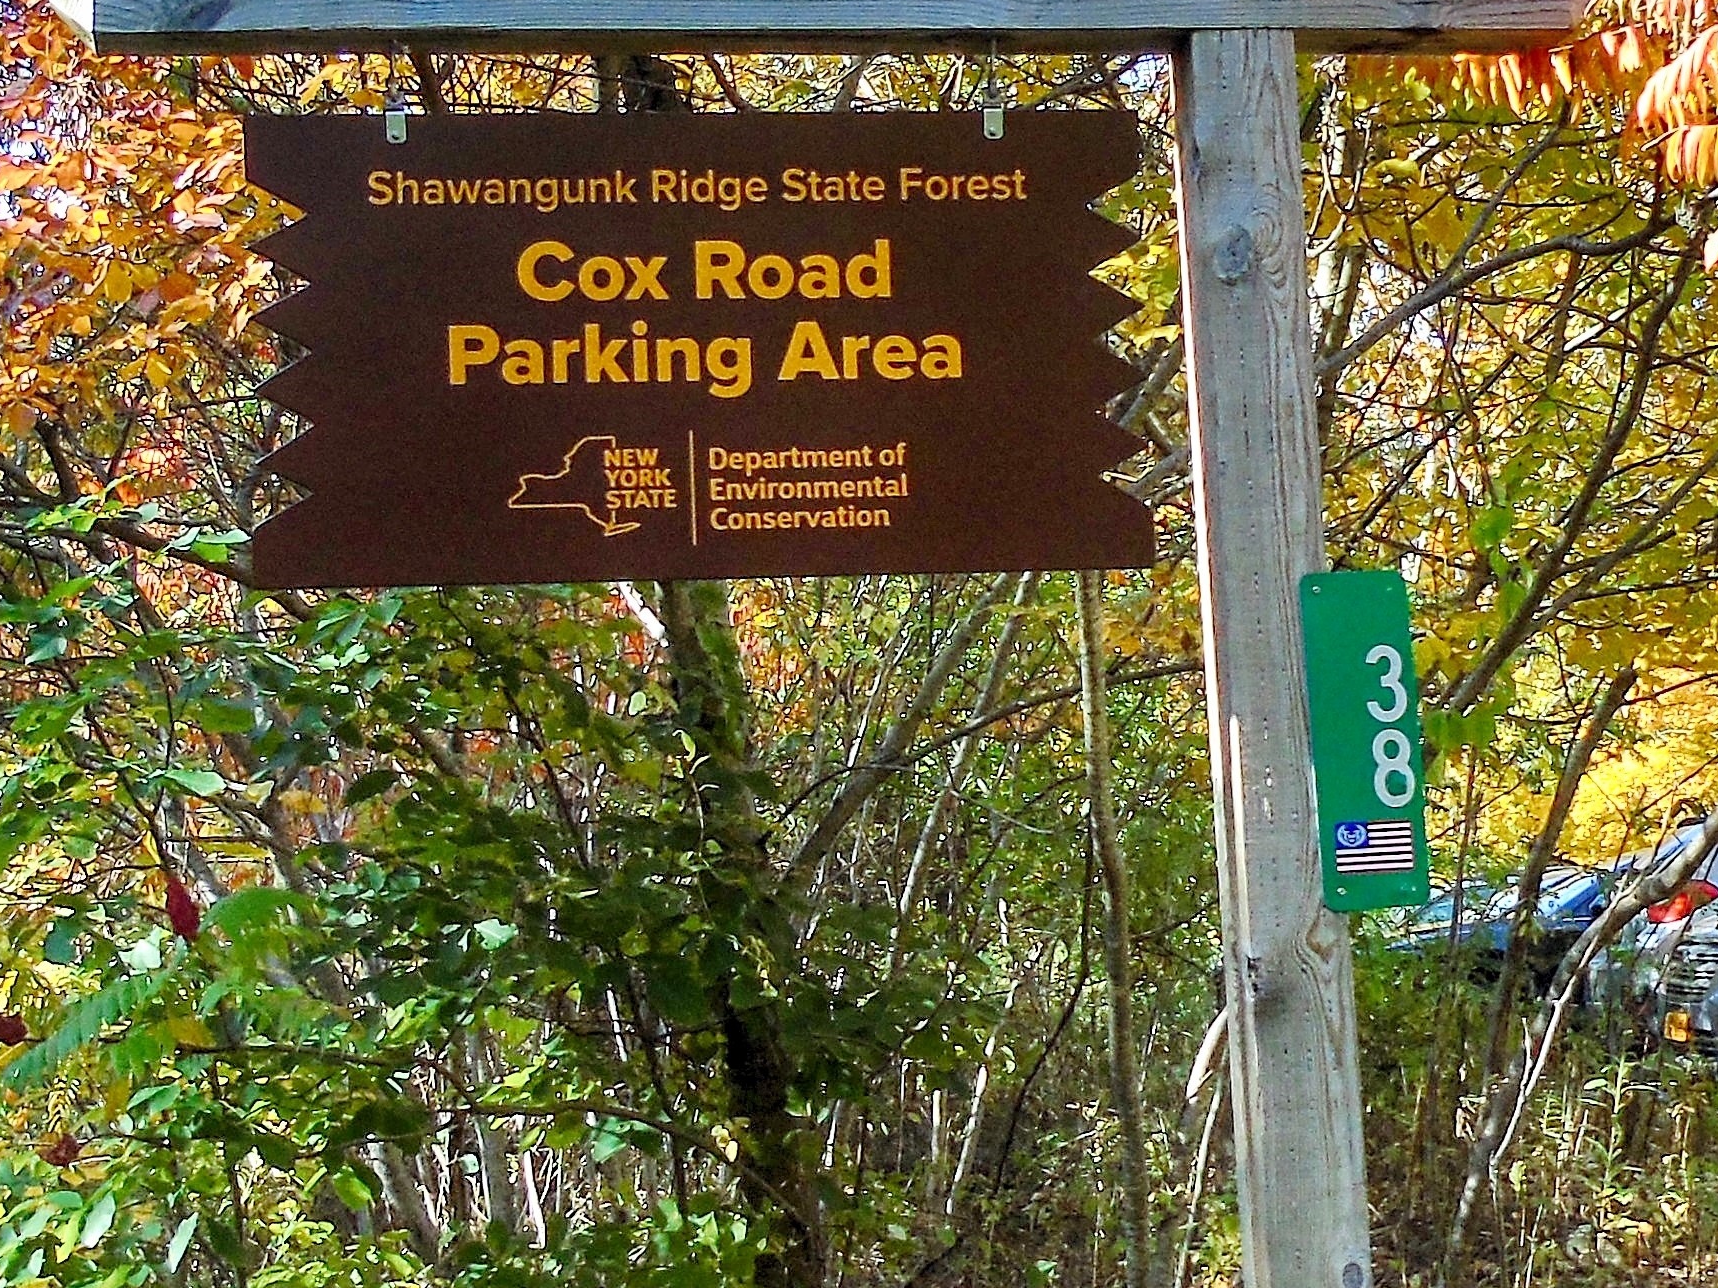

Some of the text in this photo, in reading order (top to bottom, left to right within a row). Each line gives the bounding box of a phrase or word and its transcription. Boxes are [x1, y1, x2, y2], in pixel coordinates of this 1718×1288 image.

[367, 167, 1028, 213] Shawangunk Ridge State Forest
[515, 238, 892, 302] Cox Road
[447, 320, 963, 399] Parking Area
[603, 448, 659, 468] NEW
[708, 442, 907, 477] Department of
[604, 468, 672, 488] YORK
[709, 473, 909, 501] Environmental
[605, 489, 678, 509] STATE
[710, 505, 891, 531] Conservation
[1364, 644, 1416, 808] 38
